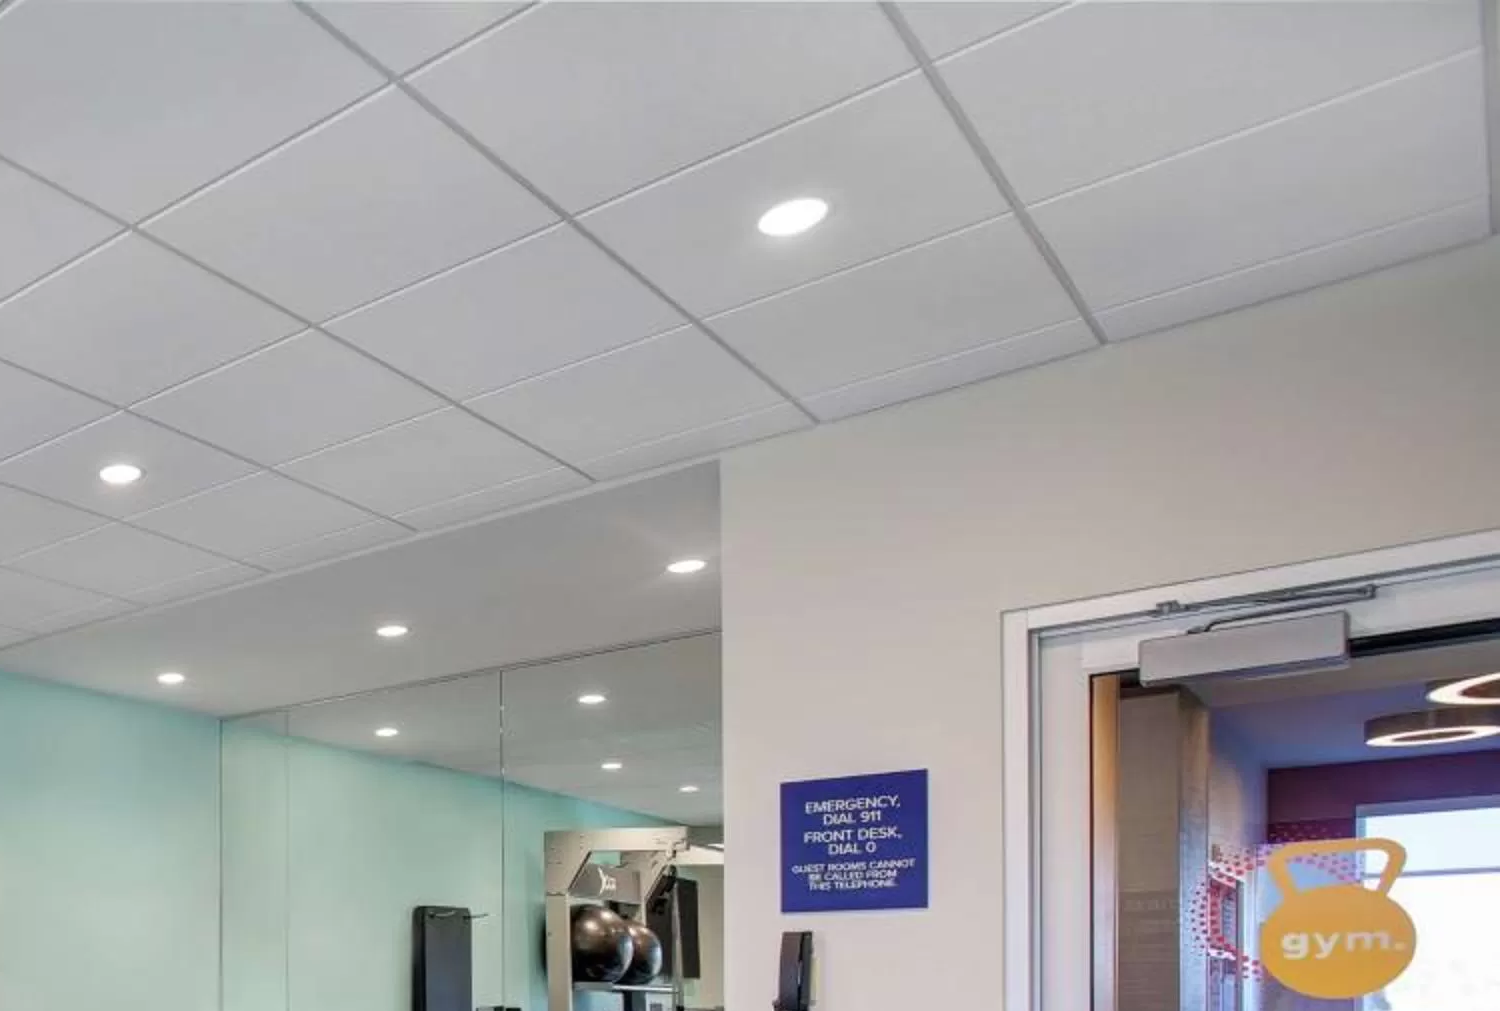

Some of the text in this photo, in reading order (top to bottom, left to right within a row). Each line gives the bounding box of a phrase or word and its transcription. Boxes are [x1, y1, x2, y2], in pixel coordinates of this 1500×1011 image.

[823, 810, 882, 825] DIAL 911
[803, 829, 851, 843] FRONT
[828, 843, 861, 855] DIAL
[828, 861, 867, 872] ROOMS
[869, 858, 916, 869] CANNOT
[866, 869, 897, 879] FROM
